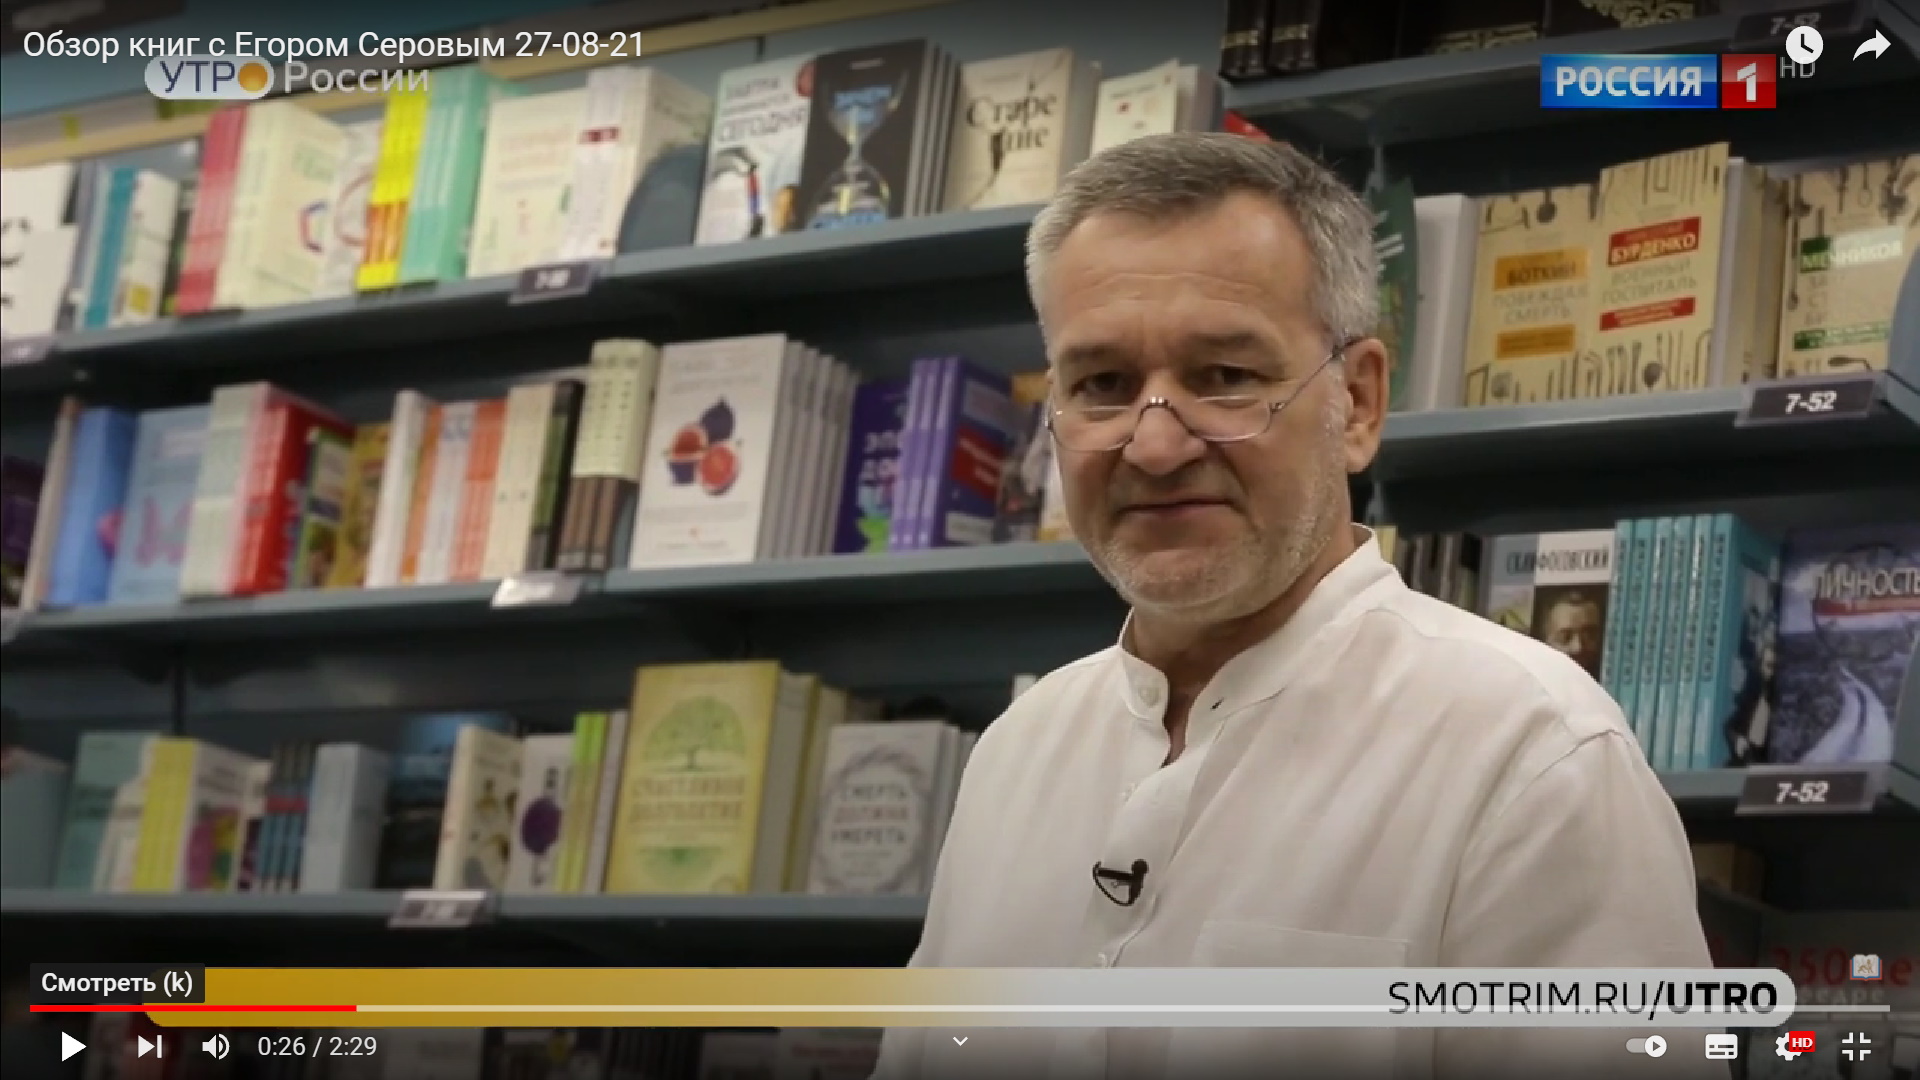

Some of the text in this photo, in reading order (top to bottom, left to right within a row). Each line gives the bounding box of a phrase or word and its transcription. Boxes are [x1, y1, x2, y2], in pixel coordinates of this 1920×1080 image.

[1610, 231, 1697, 265] БУРДЕНКО
[1784, 389, 1838, 414] 7-52
[1774, 781, 1830, 805] 7-52
